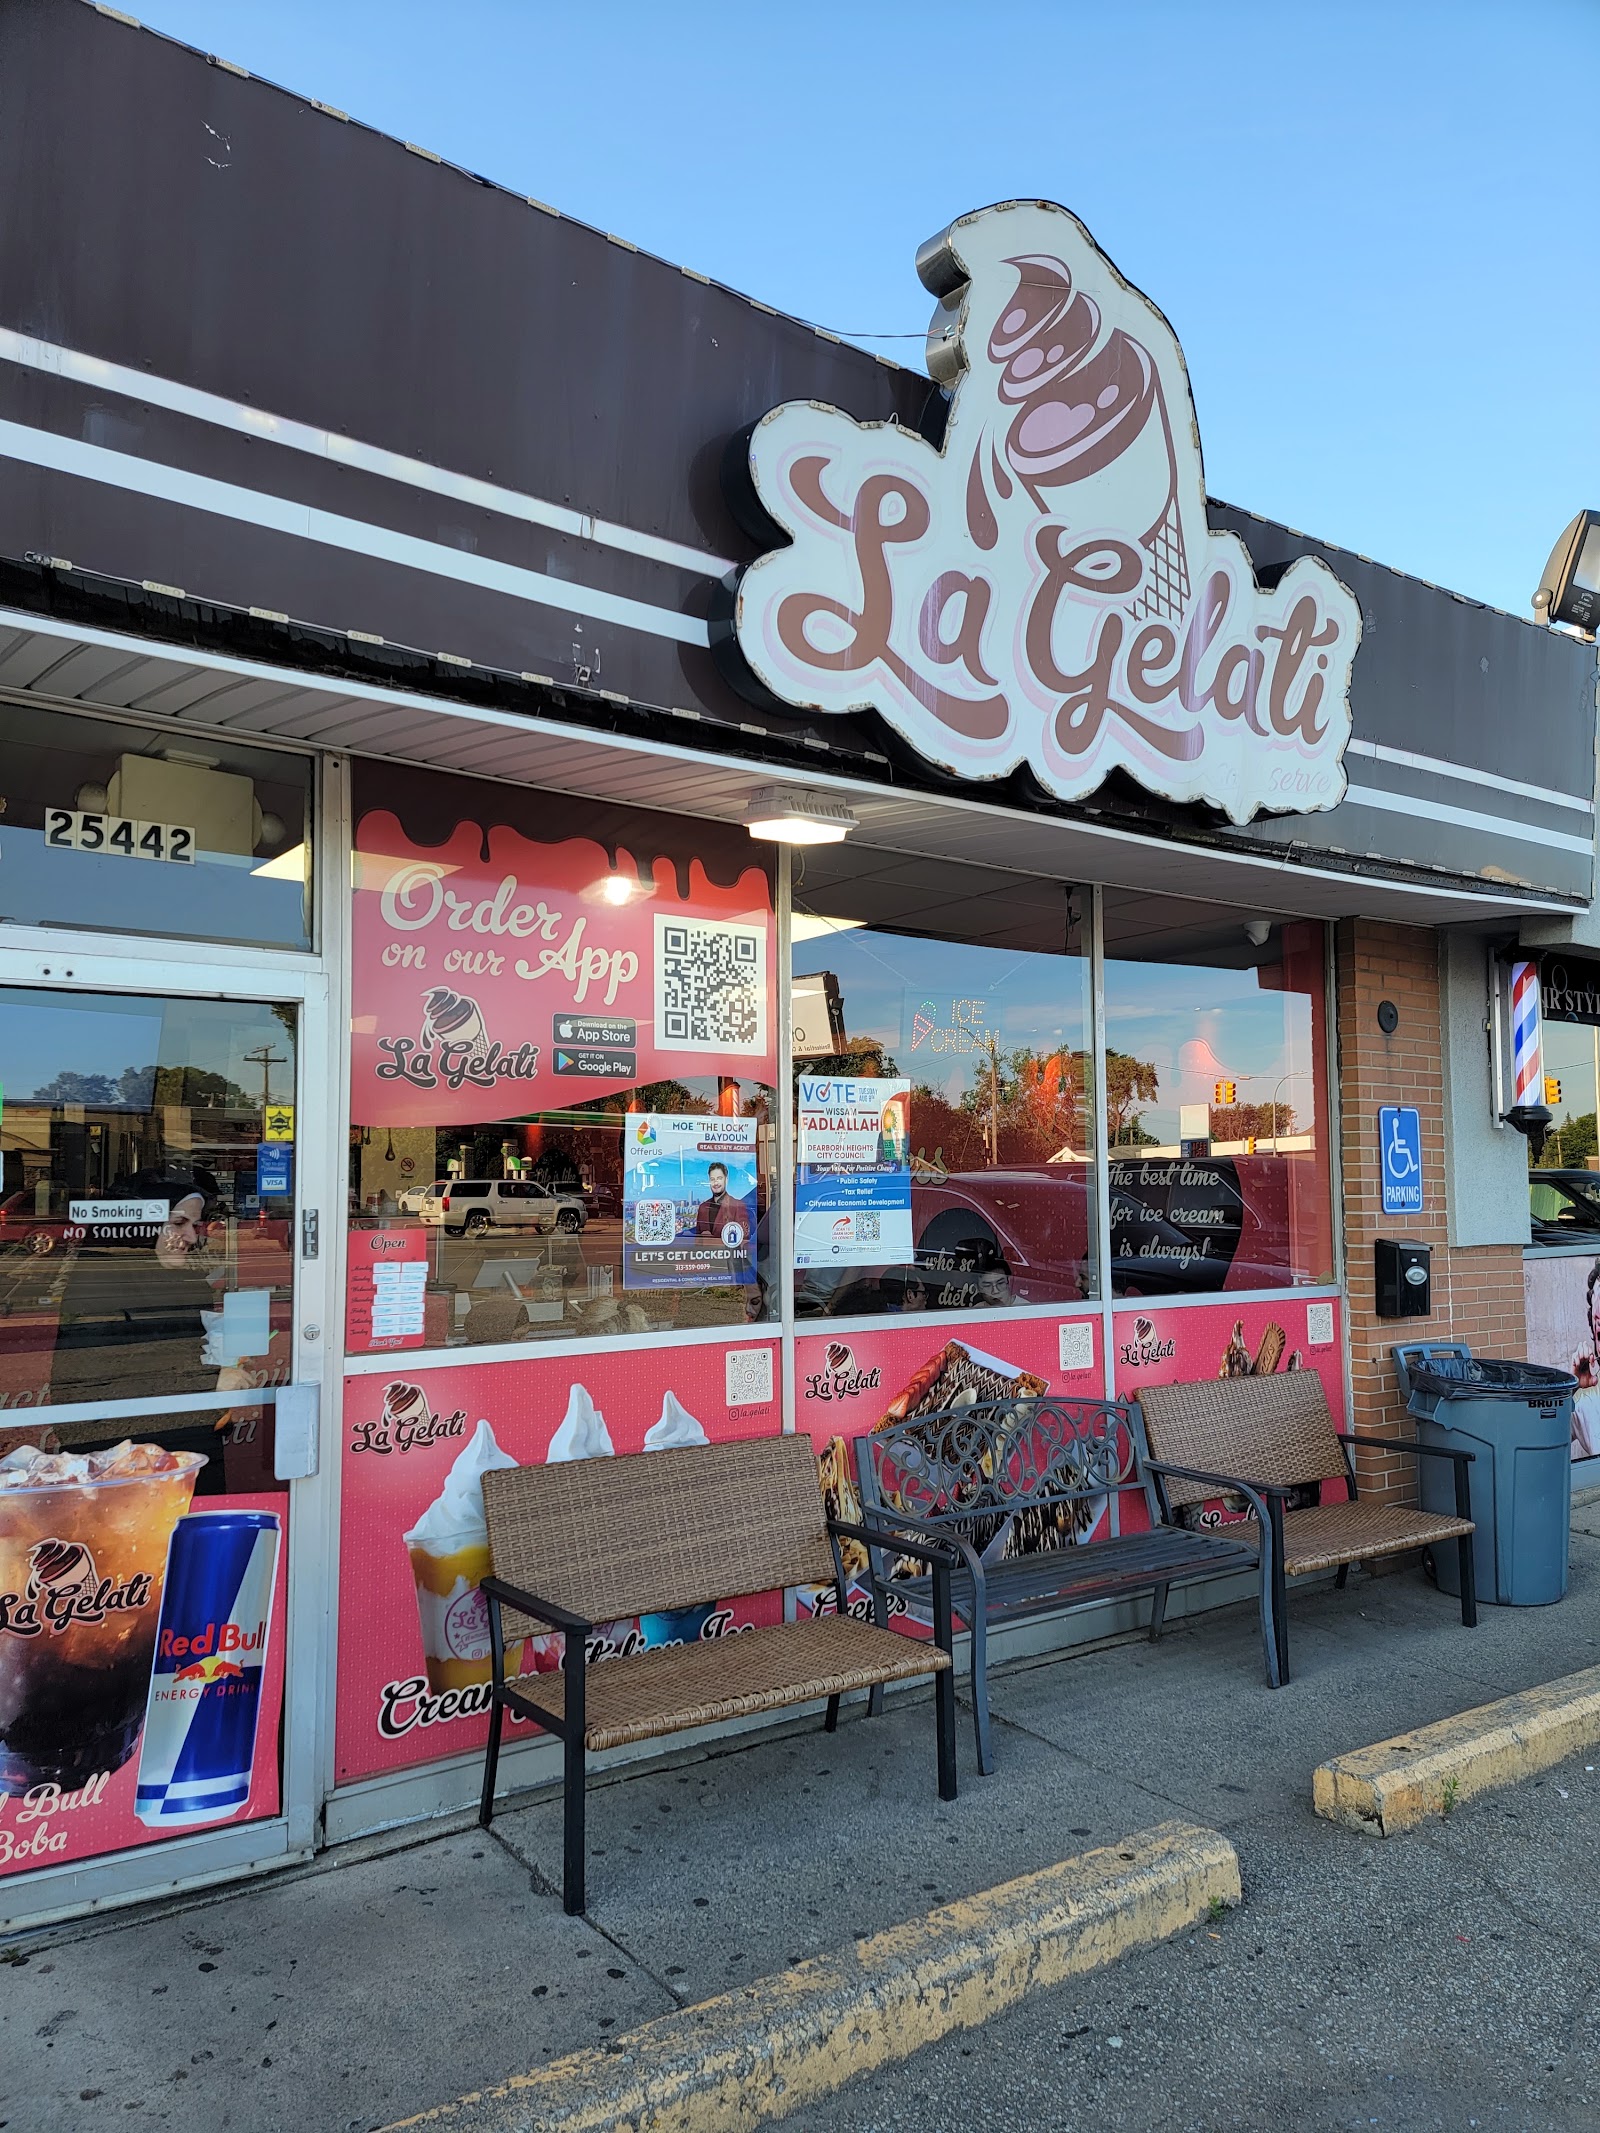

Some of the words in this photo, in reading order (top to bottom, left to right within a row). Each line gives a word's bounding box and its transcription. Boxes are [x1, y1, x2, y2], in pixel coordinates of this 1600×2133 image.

[776, 456, 1010, 739] La
[1026, 525, 1340, 762] Gelati
[48, 810, 192, 863] 25442
[380, 864, 562, 942] Order
[381, 943, 428, 970] on
[443, 949, 505, 977] our
[515, 917, 640, 1006] App
[1541, 986, 1561, 1010] IR
[951, 999, 985, 1024] ICE
[576, 1028, 600, 1042] App
[601, 1029, 631, 1042] Store
[577, 1020, 608, 1029] Download
[930, 1029, 1000, 1054] CREAM
[376, 1037, 437, 1088] La
[438, 1040, 540, 1089] Gelati
[578, 1060, 612, 1074] Google
[612, 1062, 632, 1076] Play
[802, 1082, 856, 1103] VOTE
[858, 1087, 879, 1095] TUESDAY
[825, 1107, 858, 1116] WISSAM
[672, 1121, 694, 1131] MOE
[801, 1117, 879, 1131] FADLALLAH
[704, 1133, 748, 1142] BAYDOUN
[807, 1144, 845, 1152] DEARBORN
[846, 1144, 874, 1152] HEIGHTS
[859, 1177, 878, 1185] Safety
[1108, 1162, 1134, 1186] The
[1140, 1162, 1180, 1186] best
[1179, 1161, 1220, 1186] time
[808, 1200, 837, 1208] Citywide
[837, 1199, 867, 1207] Economic
[868, 1198, 905, 1207] Development
[1386, 1185, 1420, 1203] PARKING
[71, 1206, 88, 1218] No
[91, 1205, 143, 1220] Smoking
[1110, 1197, 1134, 1230] for
[1140, 1202, 1164, 1222] ice
[1169, 1207, 1225, 1224] cream
[63, 1226, 87, 1239] NO
[92, 1225, 172, 1239] SOLICITING
[304, 1209, 317, 1256] PULL
[370, 1233, 407, 1254] Open
[1119, 1237, 1133, 1257] is
[1139, 1234, 1211, 1270] always!
[666, 1251, 688, 1261] GET
[690, 1250, 731, 1260] LOCKED
[733, 1249, 748, 1259] IN!
[925, 1246, 955, 1271] who
[937, 1281, 979, 1307] diet?
[1120, 1344, 1140, 1367] La
[1141, 1339, 1175, 1366] Gelati
[805, 1374, 833, 1401] La
[834, 1367, 881, 1400] Gelati
[1527, 1399, 1564, 1408] BRUTE
[350, 1421, 393, 1455] La
[394, 1409, 467, 1452] Gelati
[0, 1593, 42, 1635] La
[45, 1573, 153, 1631] Gelati
[452, 1610, 478, 1630] La
[160, 1623, 215, 1657] Red
[218, 1621, 267, 1652] Bull
[155, 1687, 211, 1701] ENERGY
[16, 1770, 111, 1823] Bull
